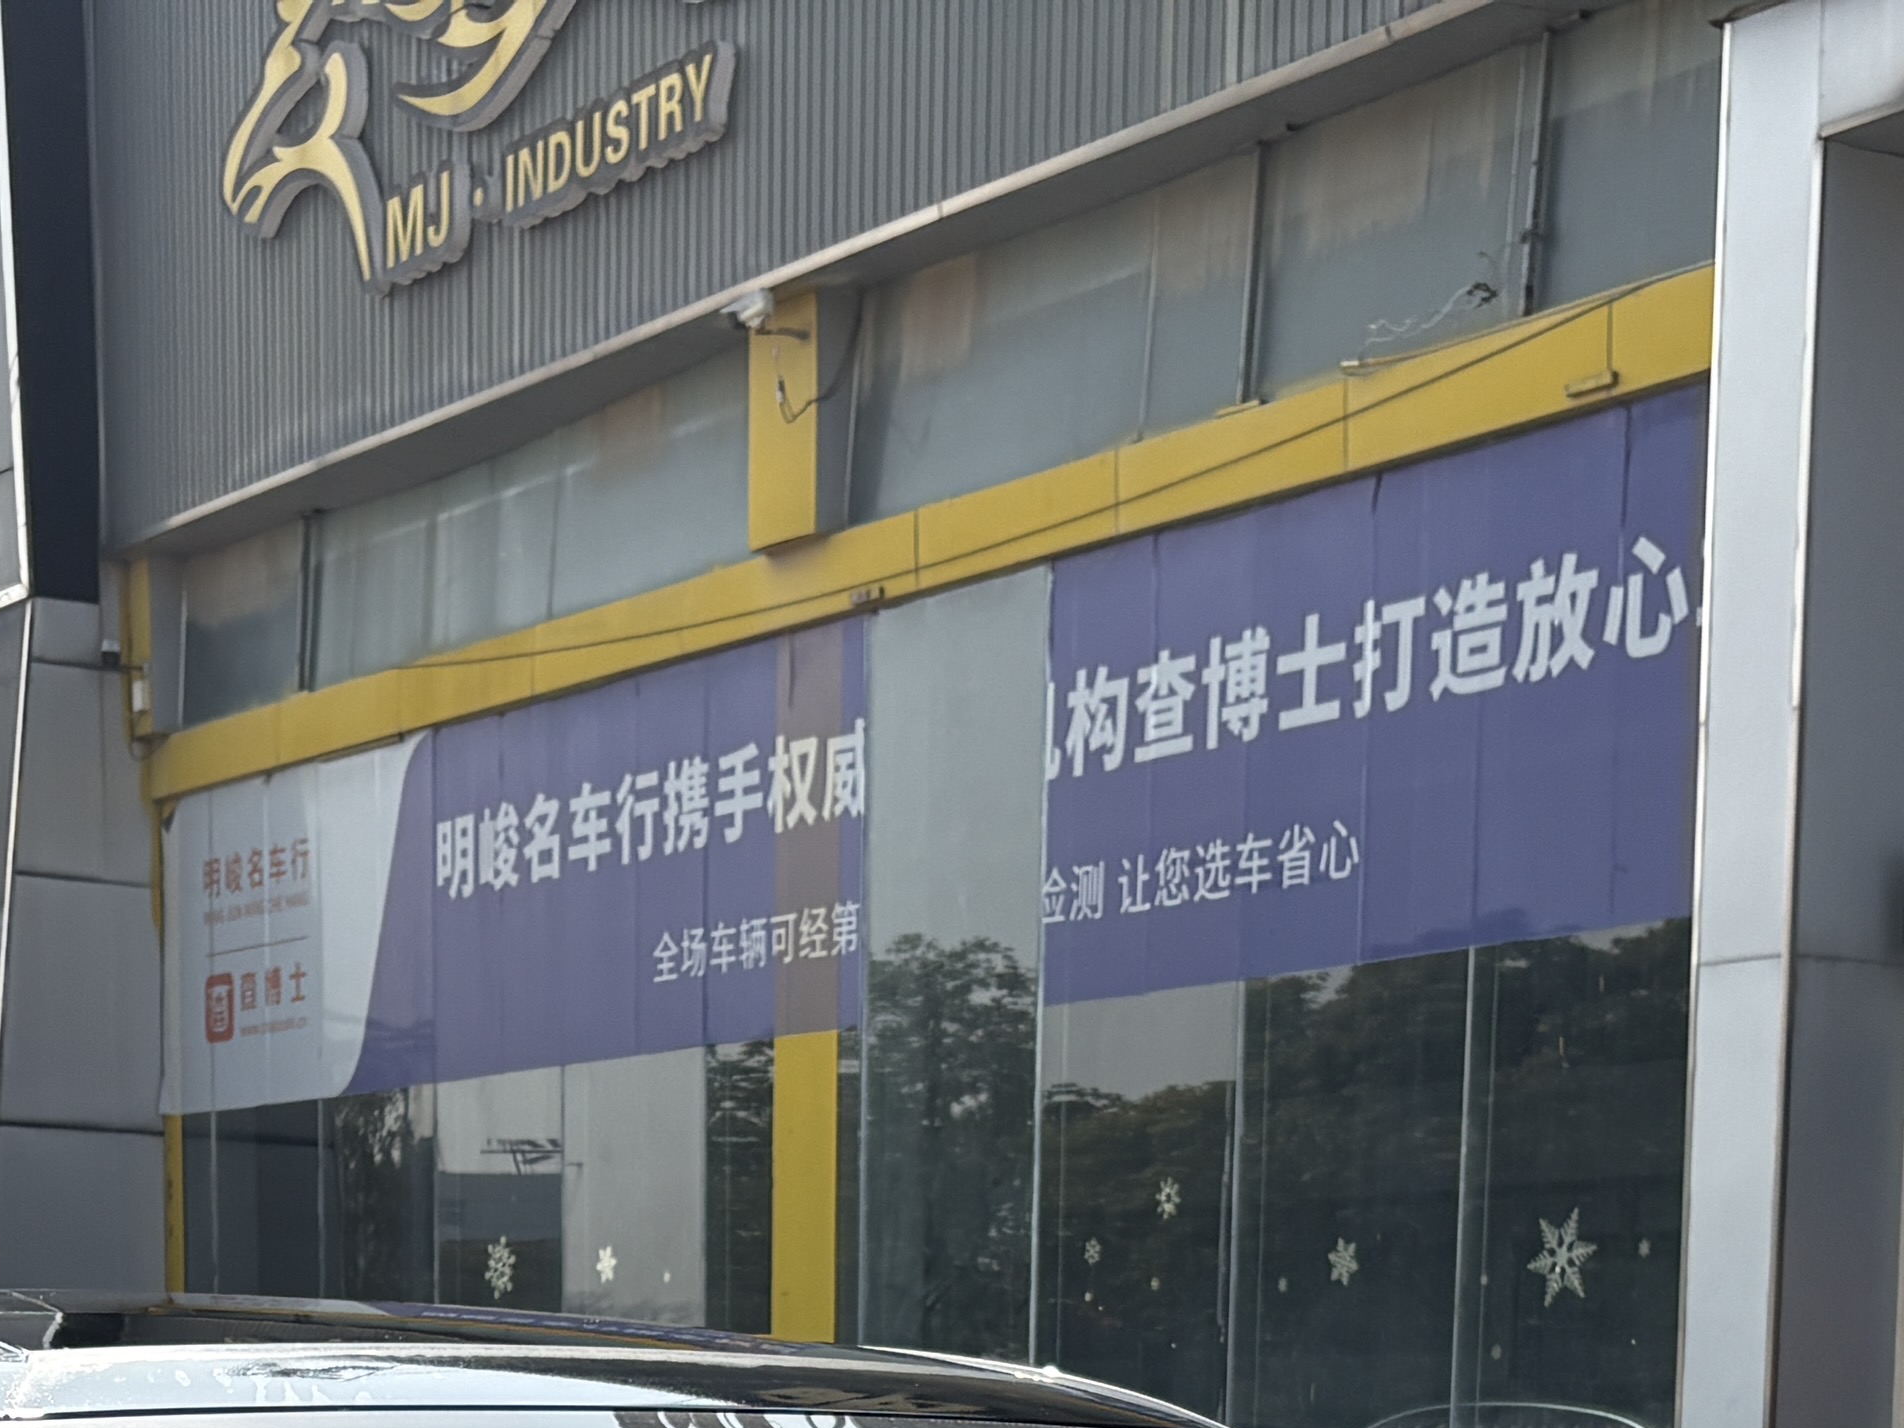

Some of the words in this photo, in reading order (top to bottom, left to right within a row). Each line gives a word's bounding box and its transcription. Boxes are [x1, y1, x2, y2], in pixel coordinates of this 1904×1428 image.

[1046, 536, 1702, 778] 构查博士打造放心
[436, 718, 865, 899] 明峻名车行携手权威
[1118, 820, 1360, 914] 让您选车省心
[653, 900, 860, 983] 全场车辆可经第
